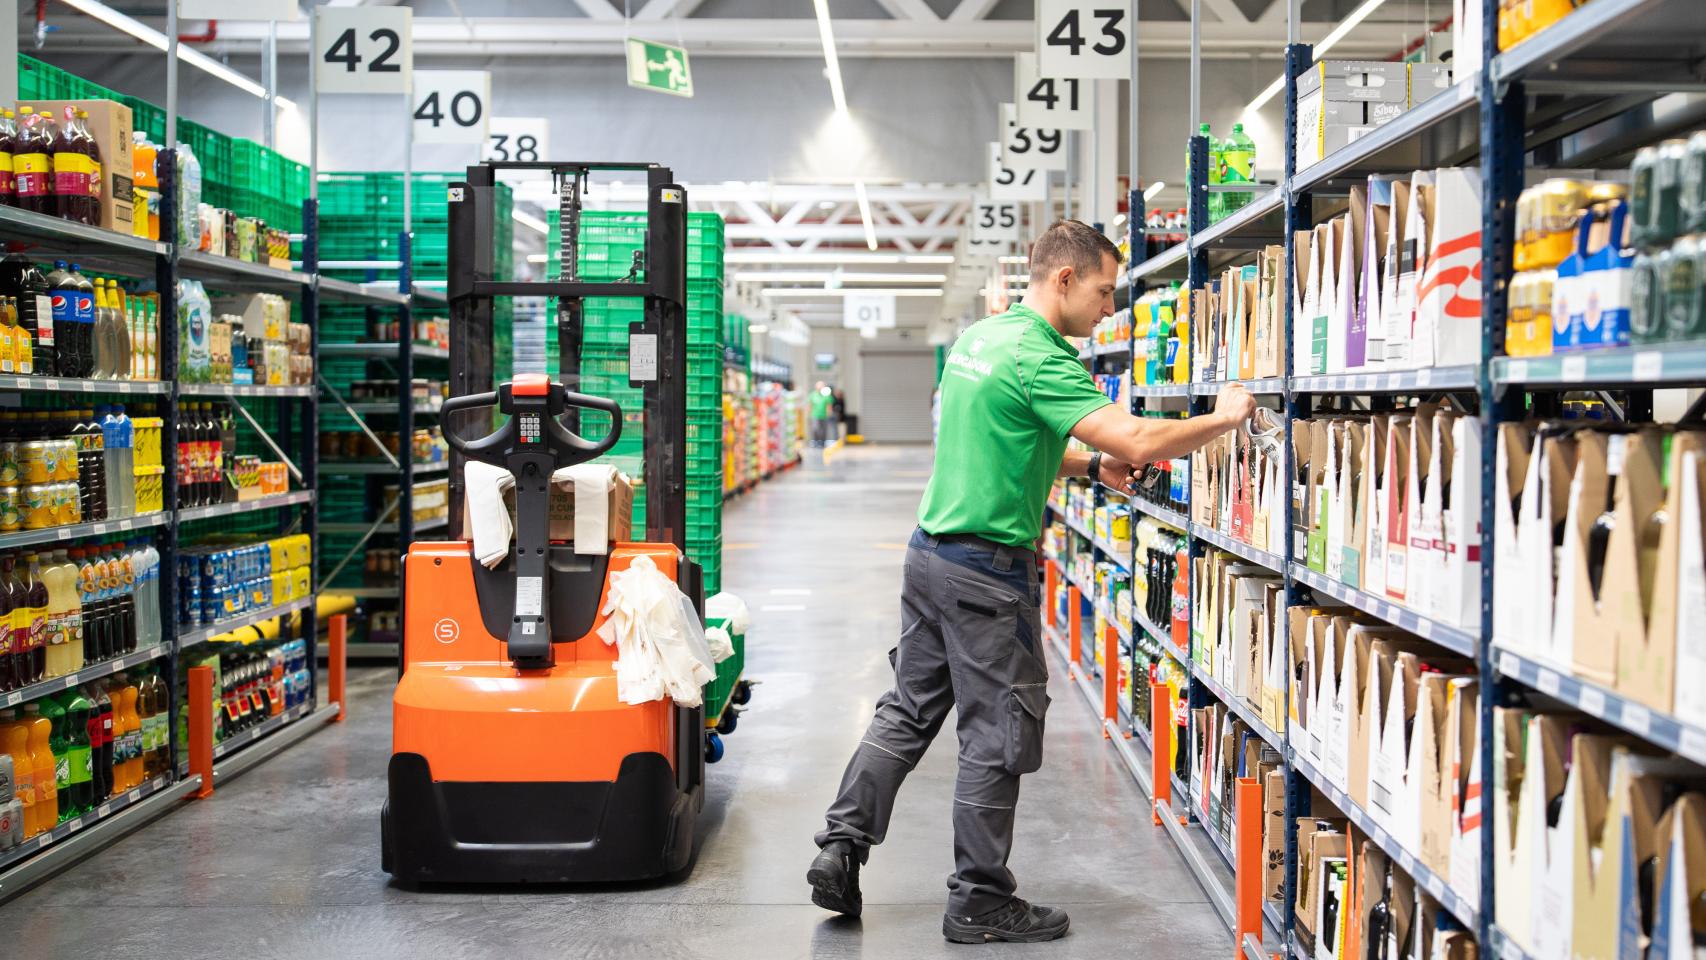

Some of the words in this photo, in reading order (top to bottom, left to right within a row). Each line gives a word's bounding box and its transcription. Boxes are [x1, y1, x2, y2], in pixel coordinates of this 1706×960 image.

[1047, 9, 1126, 56] 43
[324, 28, 401, 72] 42
[413, 90, 482, 127] 40
[1027, 79, 1079, 111] 41
[488, 135, 539, 161] 38
[1009, 125, 1061, 154] 39
[980, 205, 1015, 228] 35
[858, 306, 881, 322] 01
[440, 624, 453, 638] S
